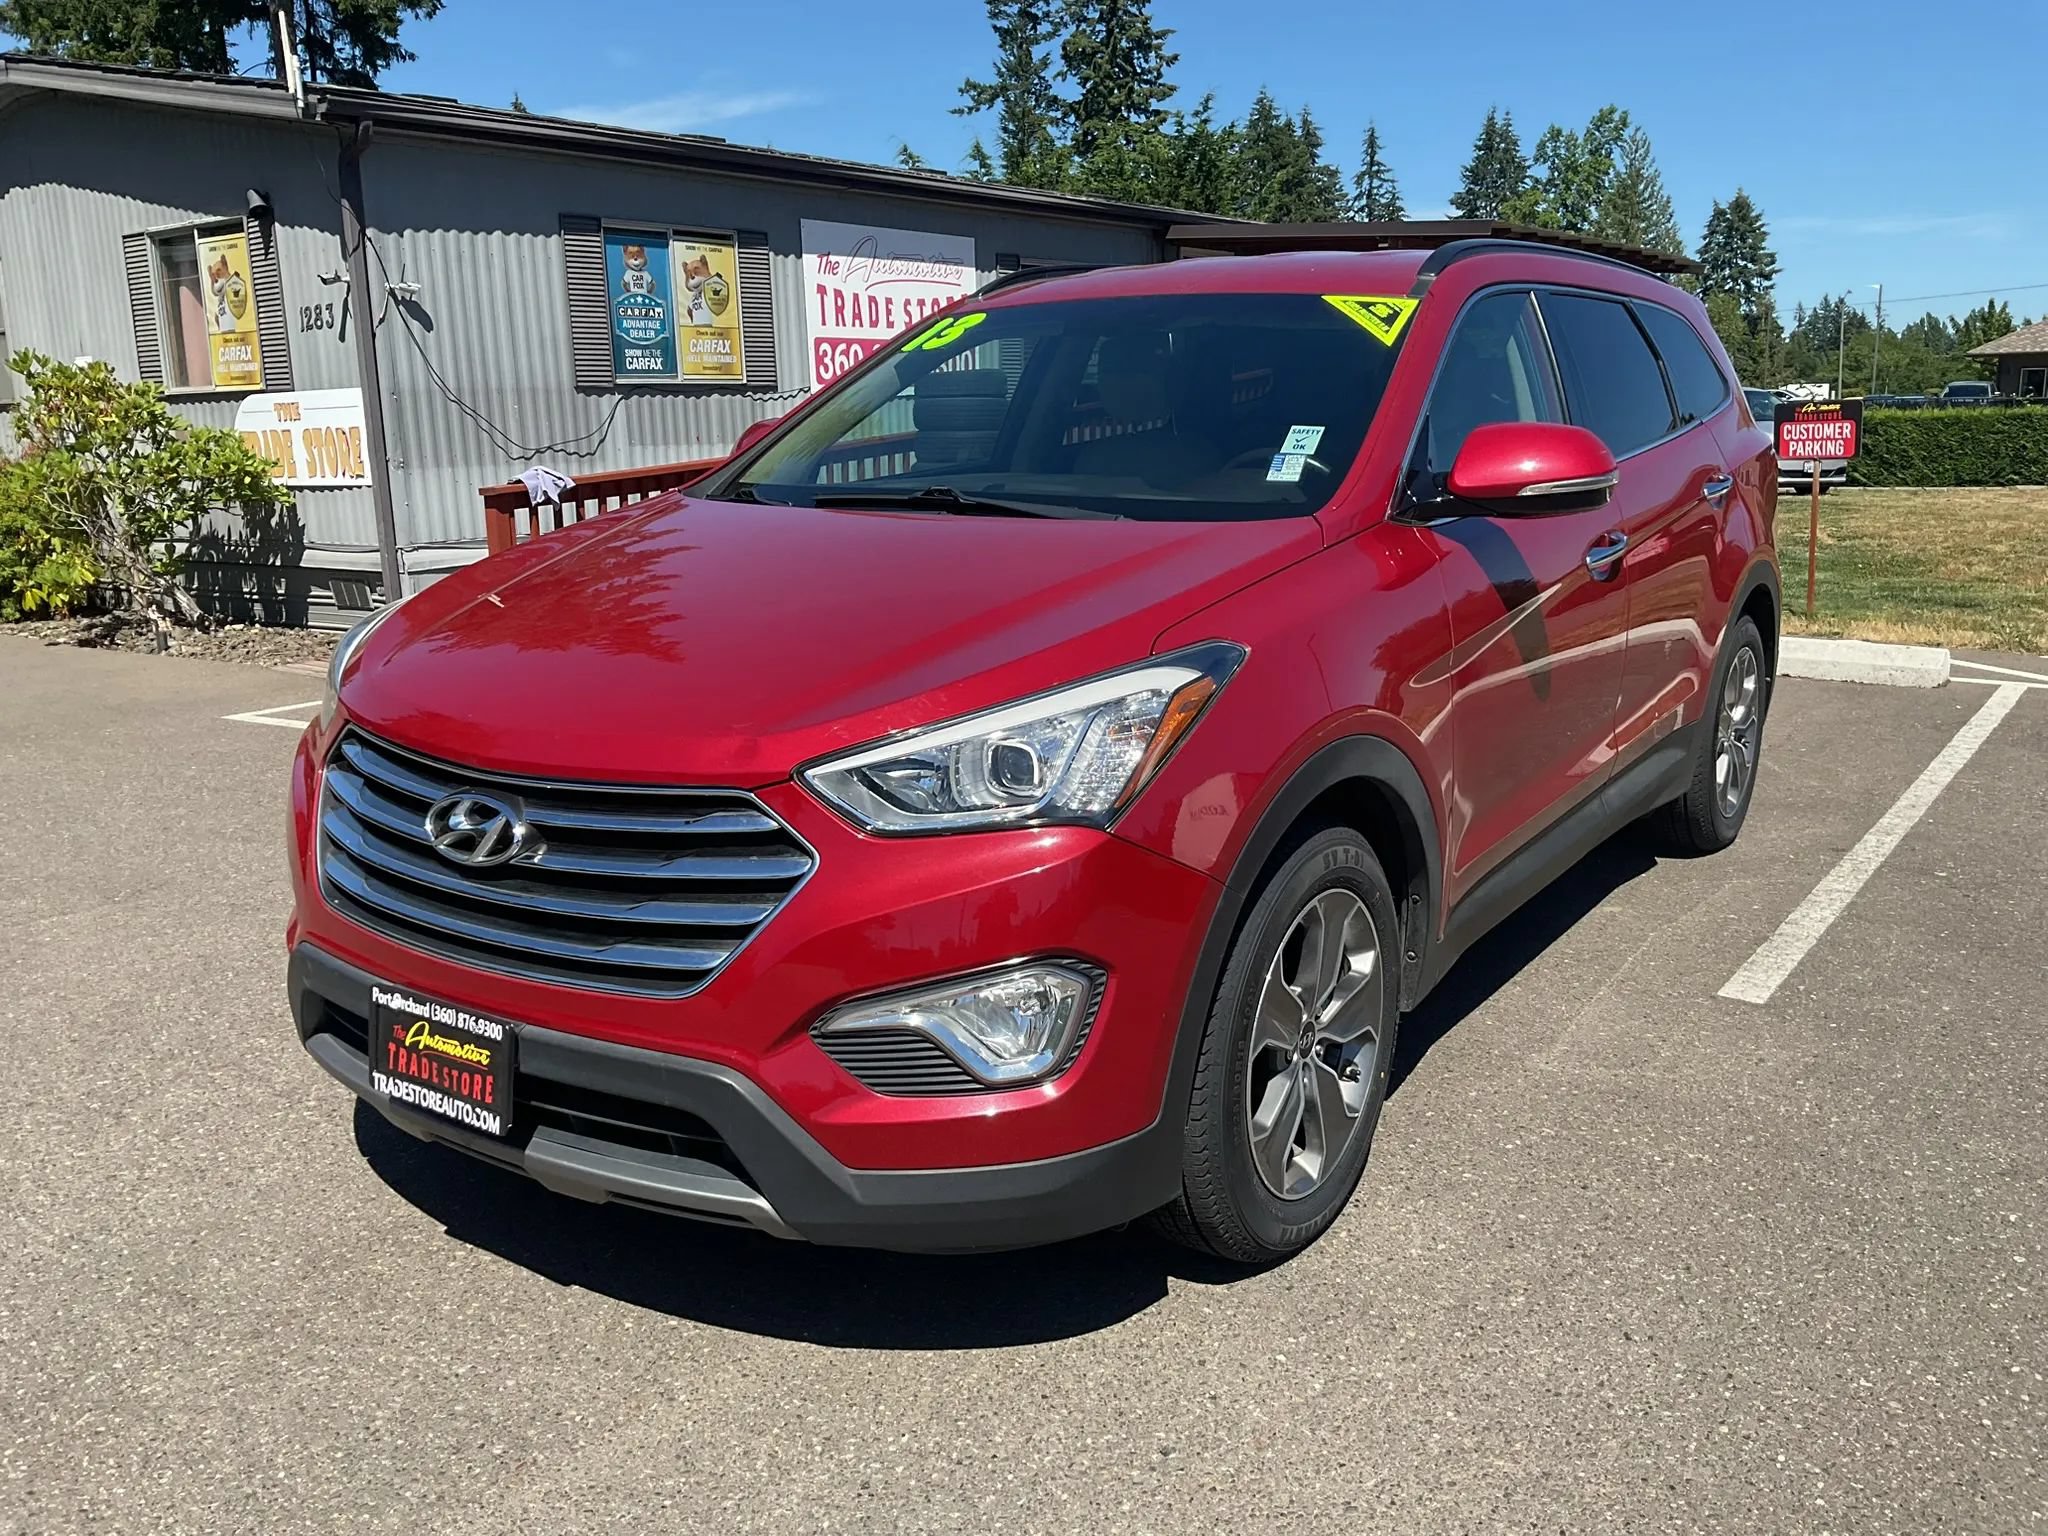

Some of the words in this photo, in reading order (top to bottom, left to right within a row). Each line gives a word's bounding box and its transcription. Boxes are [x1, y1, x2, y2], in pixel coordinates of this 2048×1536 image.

[816, 252, 839, 276] The
[842, 235, 964, 282] Automotive
[619, 307, 663, 318] CARFAX
[816, 284, 895, 329] TRADE
[903, 294, 968, 331] STO
[300, 302, 334, 333] 1283
[623, 320, 661, 329] ADVANTAGE
[629, 330, 655, 338] DEALER
[219, 345, 253, 361] CARFAX
[624, 349, 642, 357] SHOW
[690, 339, 731, 353] CARFAX
[626, 357, 663, 370] CARFAX
[274, 402, 301, 422] THE
[1783, 423, 1851, 440] CUSTOMER
[303, 426, 365, 479] STORE
[1789, 440, 1845, 457] PARKING
[372, 986, 392, 1005] Port
[431, 1003, 456, 1027] (360)
[393, 1024, 407, 1041] The
[404, 1021, 491, 1065] Automotive
[388, 1042, 439, 1084] TRADE
[443, 1066, 494, 1104] STORE
[372, 1071, 500, 1135] TRADESTOREAUTO.COM
